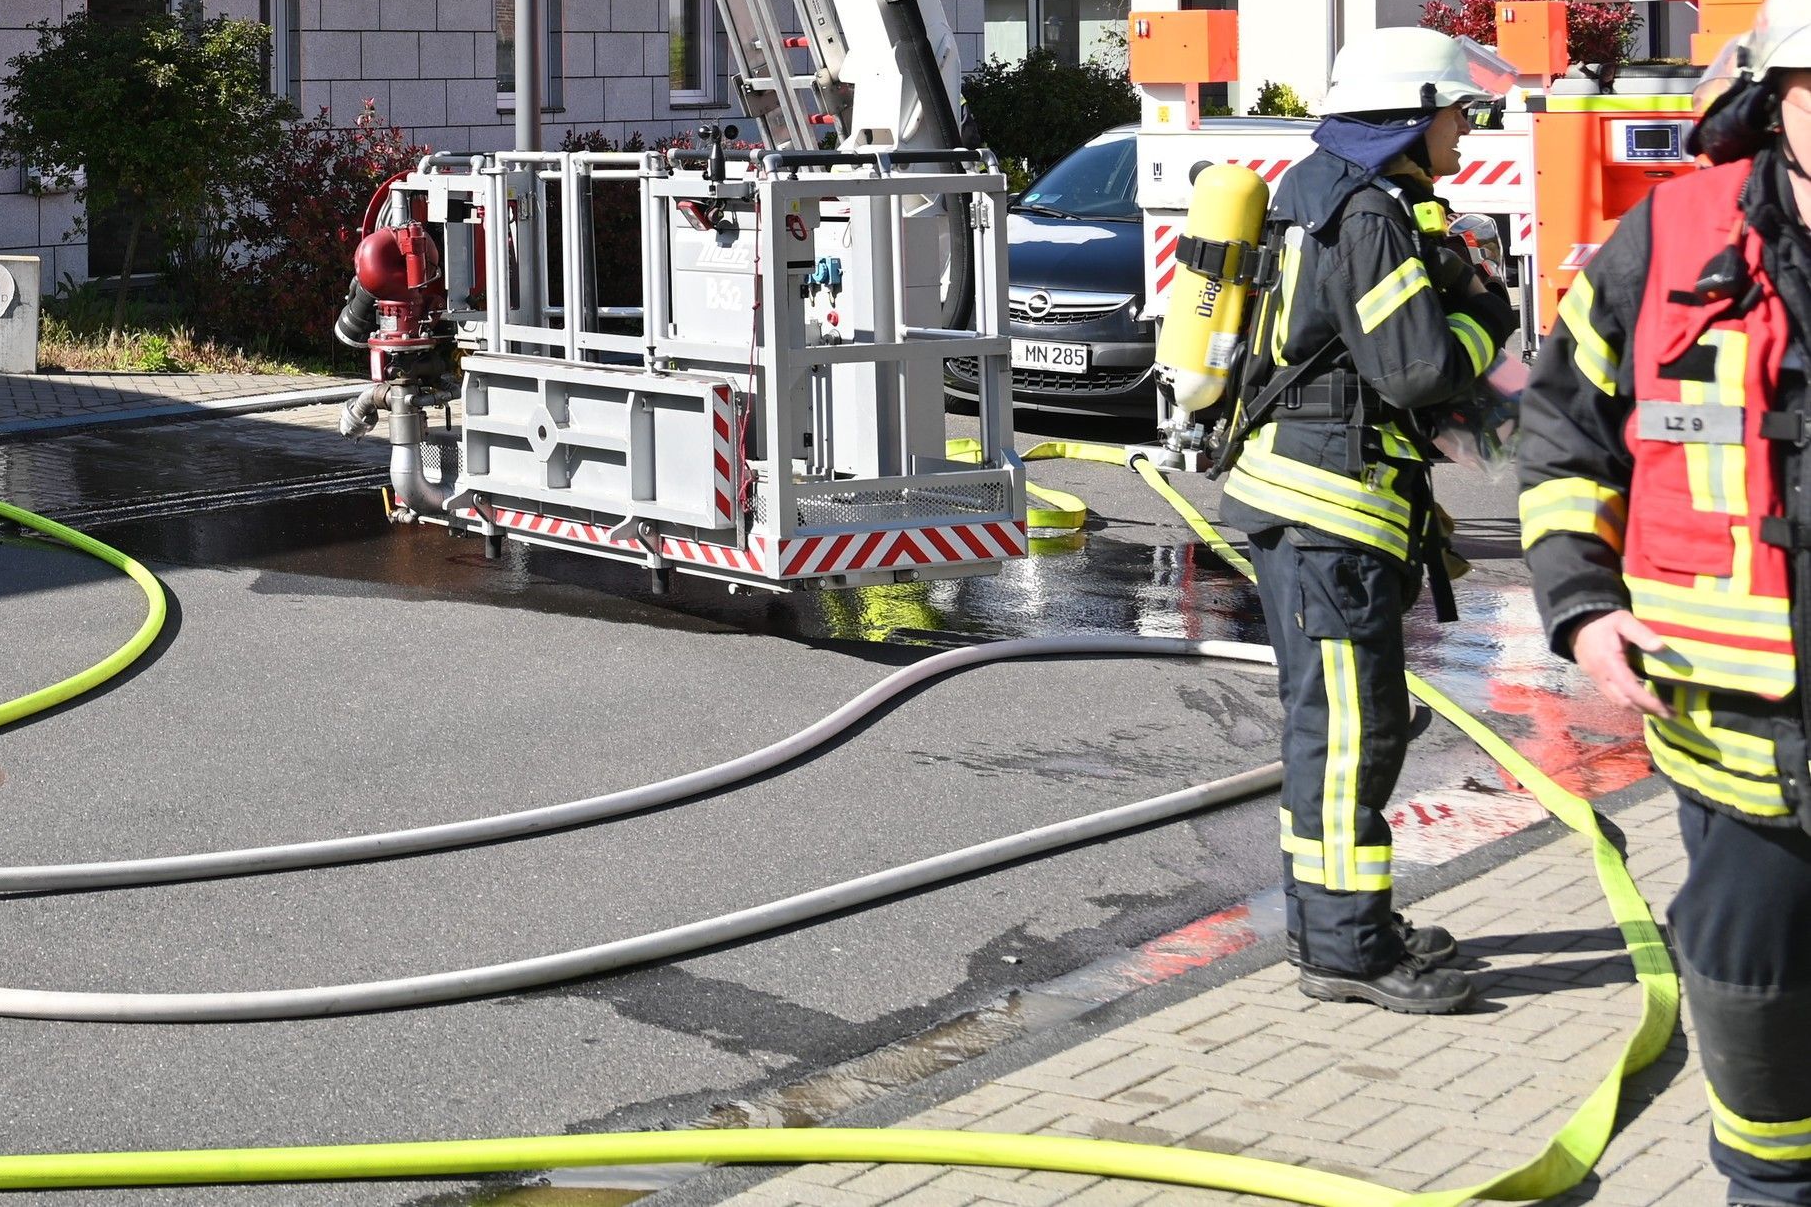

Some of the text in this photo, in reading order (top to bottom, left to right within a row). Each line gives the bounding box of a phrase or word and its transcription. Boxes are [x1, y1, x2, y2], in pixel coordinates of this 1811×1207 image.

[706, 277, 743, 311] B32
[1025, 344, 1085, 366] MN 285
[1664, 416, 1685, 431] LZ
